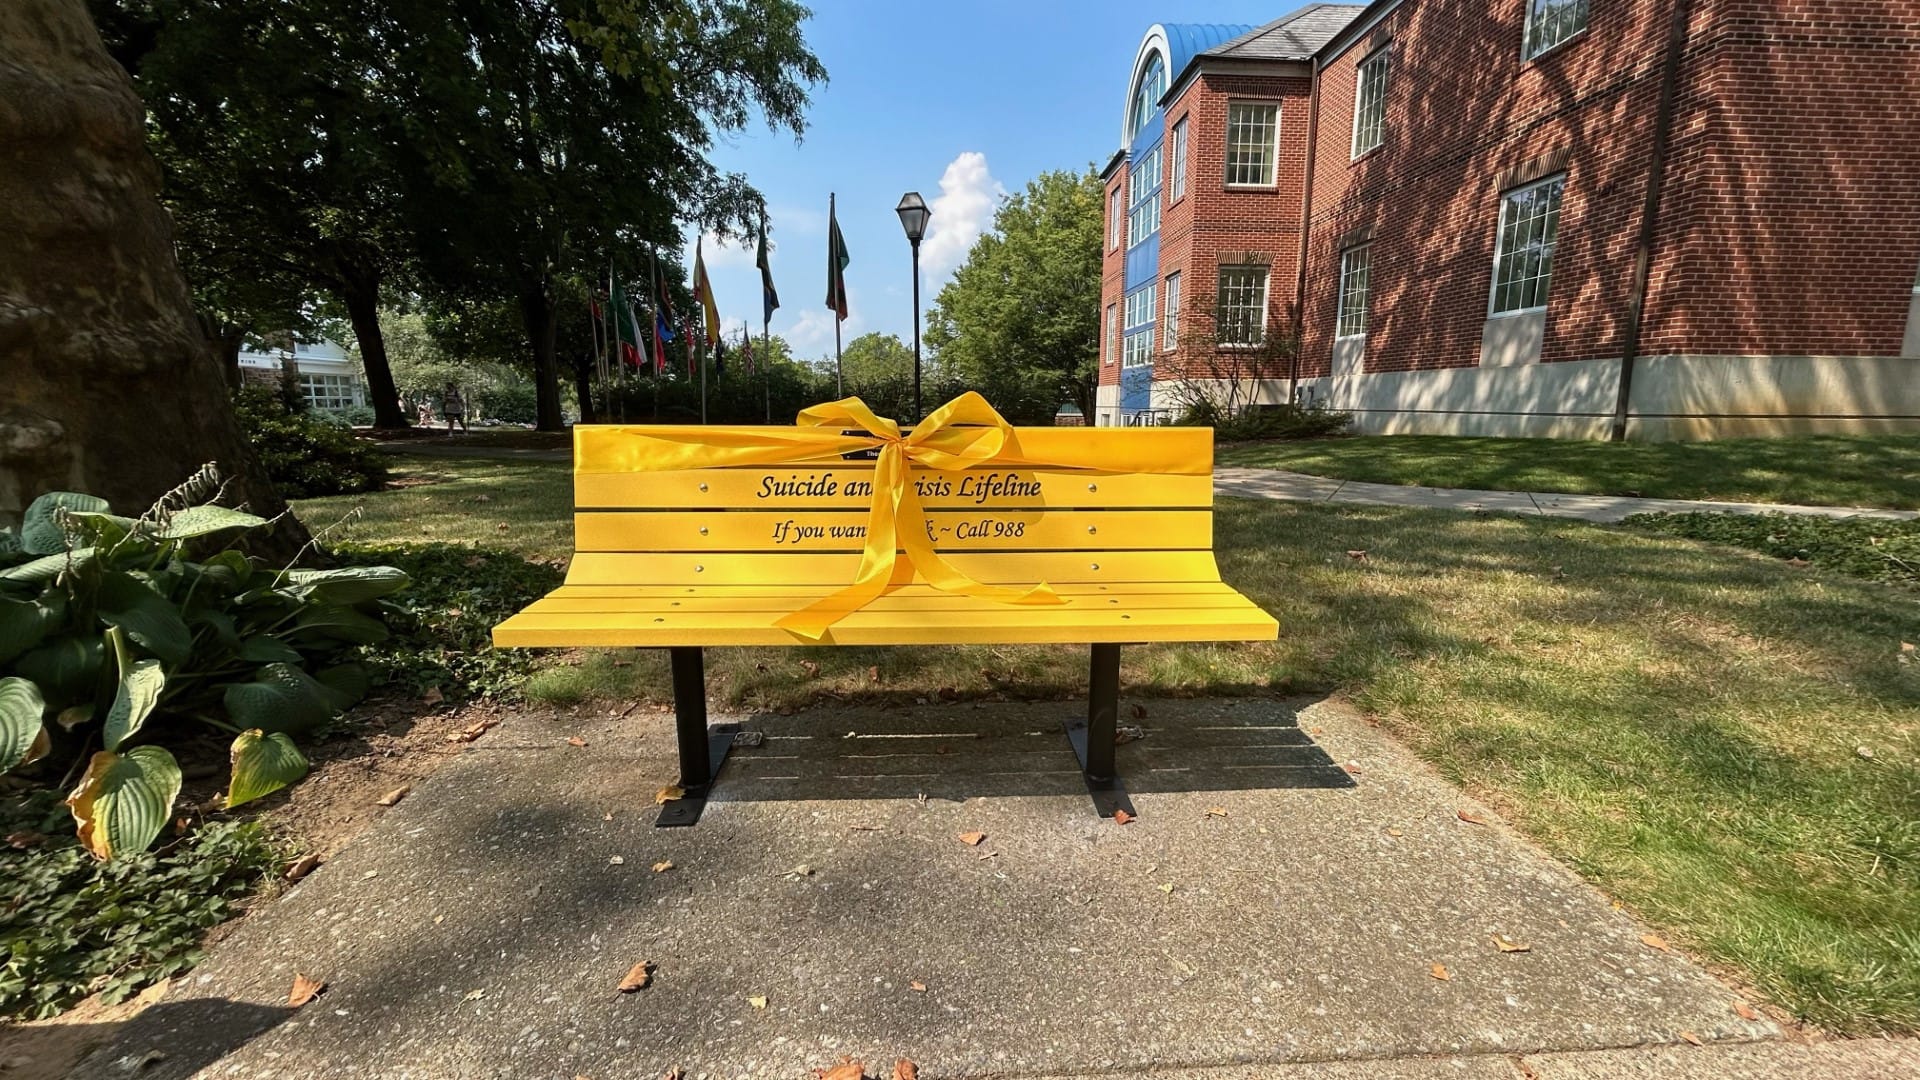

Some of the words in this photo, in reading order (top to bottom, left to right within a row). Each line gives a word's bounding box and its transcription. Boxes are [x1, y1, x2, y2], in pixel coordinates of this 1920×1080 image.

[757, 473, 838, 498] Suicide
[844, 481, 873, 496] an
[956, 473, 1041, 504] Lifeline
[772, 520, 794, 544] If
[791, 526, 825, 544] you
[829, 526, 867, 538] wan
[956, 519, 993, 540] Call
[994, 521, 1025, 538] 988
